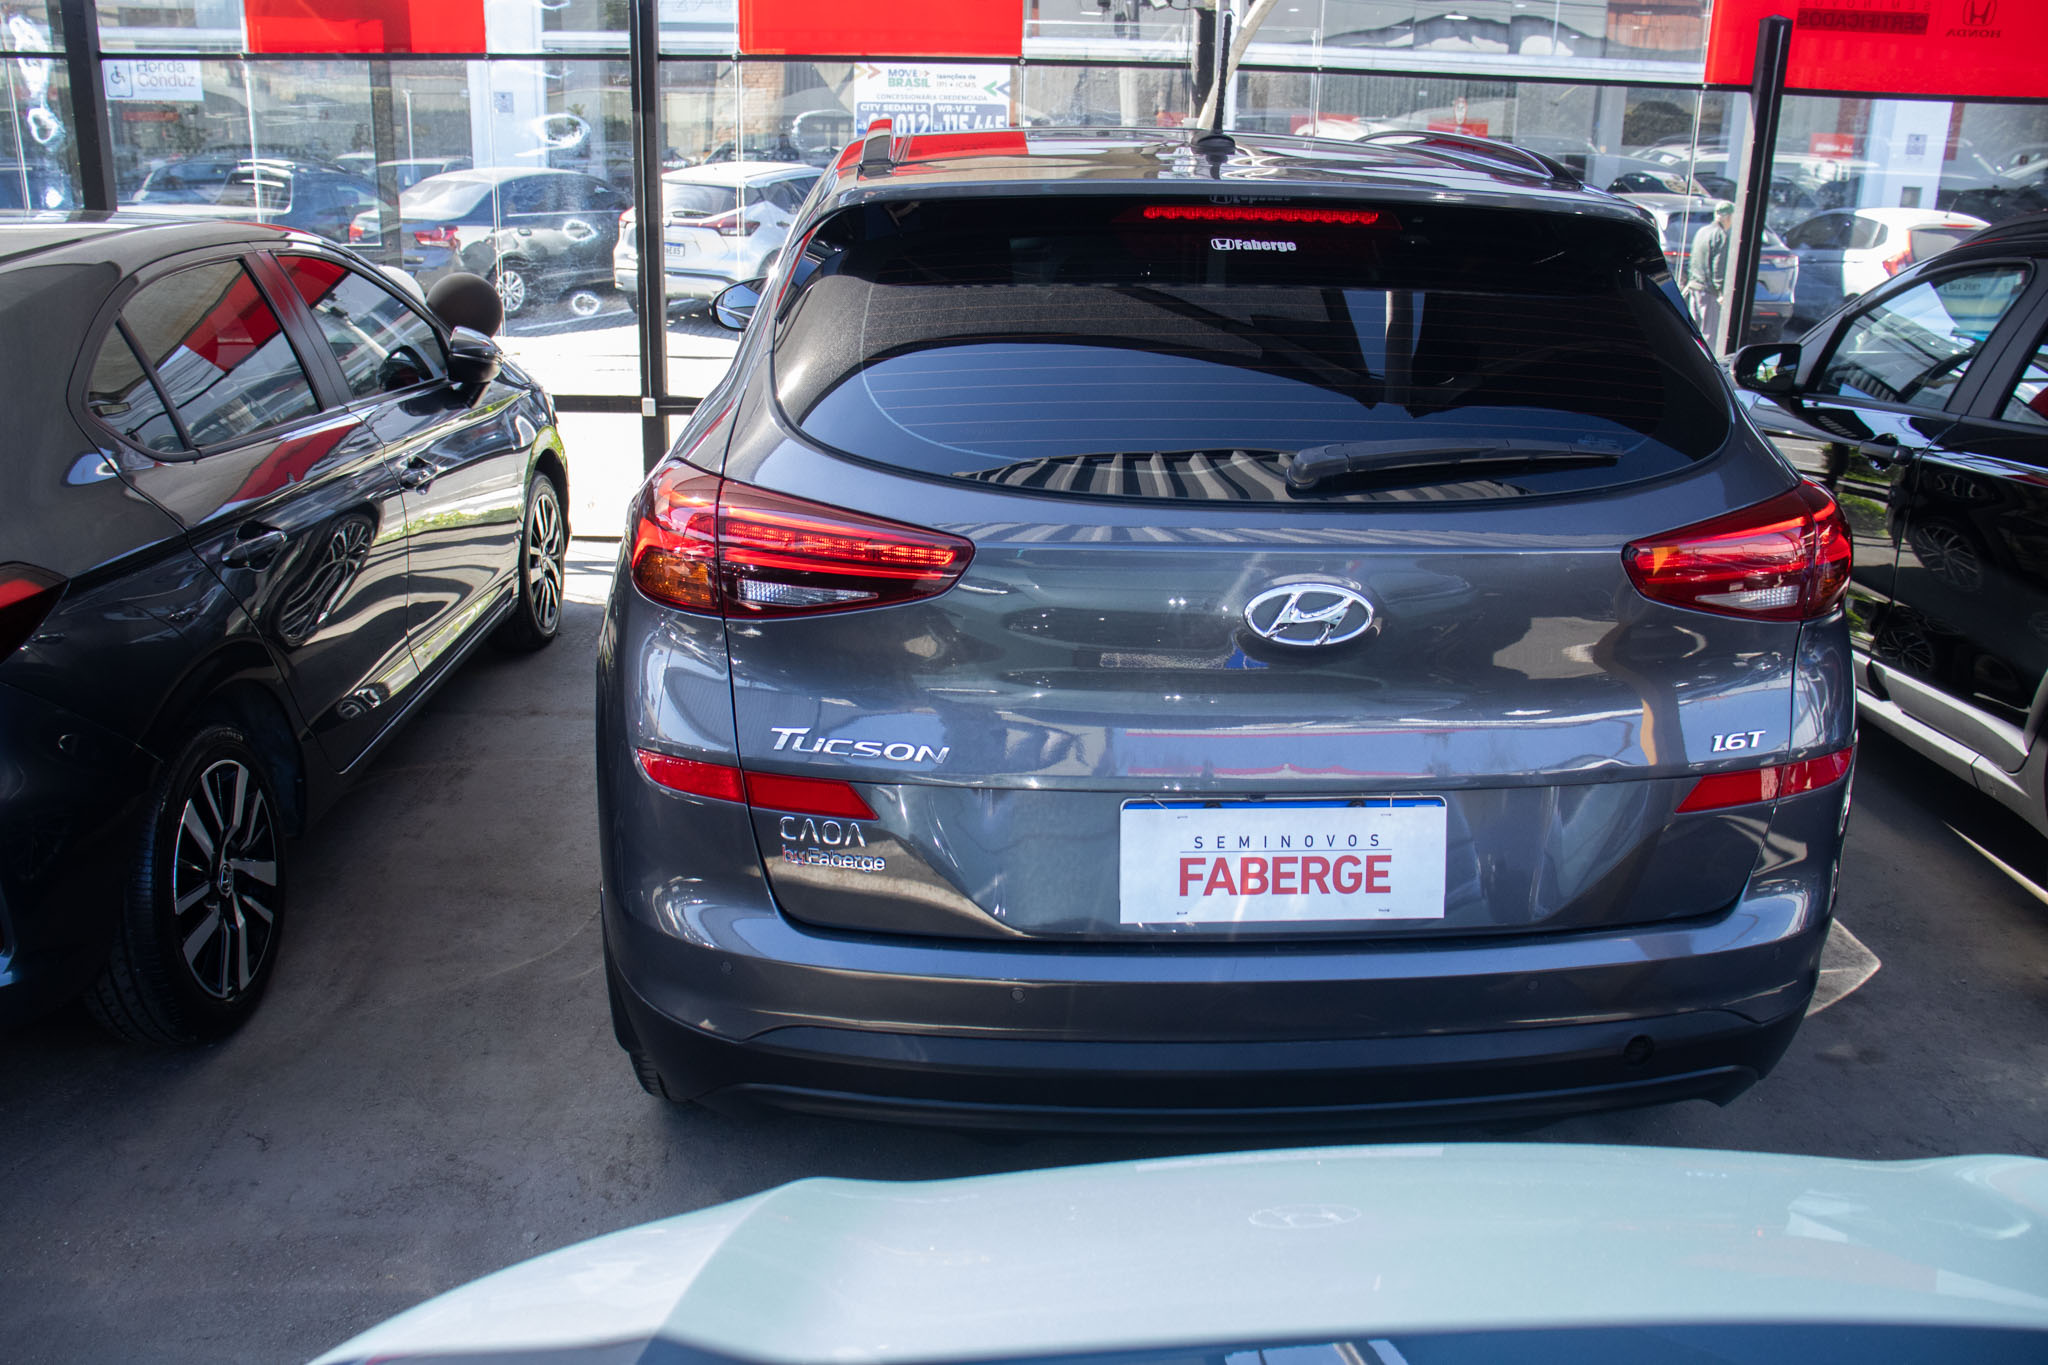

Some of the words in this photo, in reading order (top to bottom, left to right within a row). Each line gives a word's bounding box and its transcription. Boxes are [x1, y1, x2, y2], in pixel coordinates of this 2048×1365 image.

[136, 60, 186, 73] Honda
[888, 68, 918, 77] MOVE
[138, 72, 196, 87] Conduz
[888, 77, 930, 87] BRASIL
[860, 104, 880, 112] CITY
[883, 104, 913, 113] SEDAN
[915, 104, 928, 113] LX
[936, 105, 962, 113] WR-V
[963, 105, 976, 113] EX
[1234, 239, 1297, 252] Faberge
[770, 727, 950, 764] TUCSON
[779, 816, 866, 847] CAOA
[1193, 834, 1380, 849] SEMINOVOS
[782, 844, 806, 867] by
[807, 847, 886, 872] Faberge
[1179, 855, 1392, 897] FABERGE
